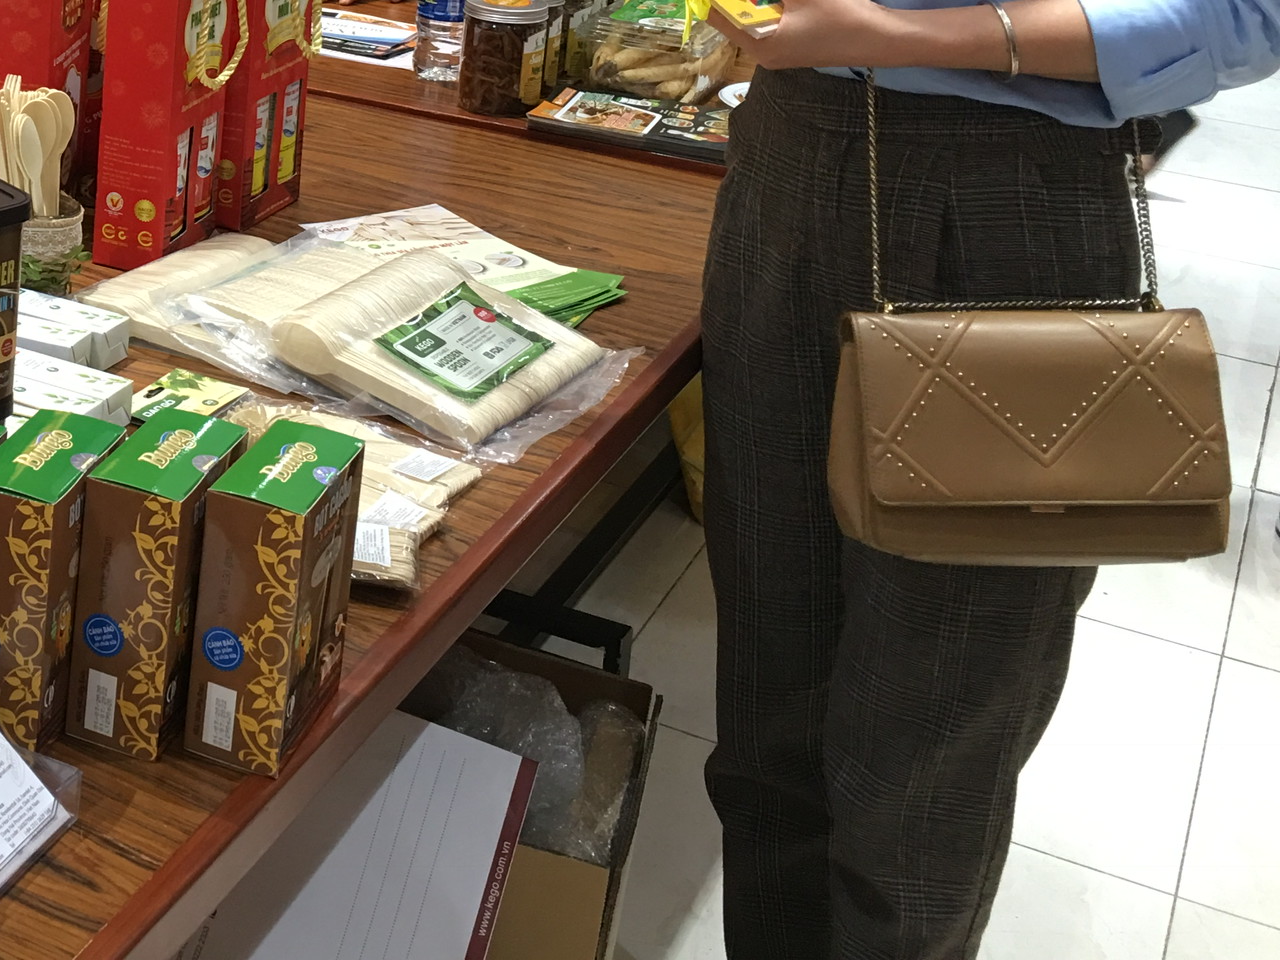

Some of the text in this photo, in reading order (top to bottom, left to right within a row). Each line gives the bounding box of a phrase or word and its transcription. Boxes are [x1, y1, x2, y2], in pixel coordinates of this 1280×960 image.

[0, 296, 8, 312] IN
[414, 338, 435, 352] KEGO
[434, 348, 464, 369] WOODEN
[447, 356, 472, 373] SPOON
[12, 429, 73, 471] Bungo
[138, 428, 197, 469] Bungo
[259, 442, 318, 483] Bungo
[103, 624, 114, 633] BÁO
[222, 638, 235, 647] BÁO
[479, 841, 511, 936] www.kego.com.vn
